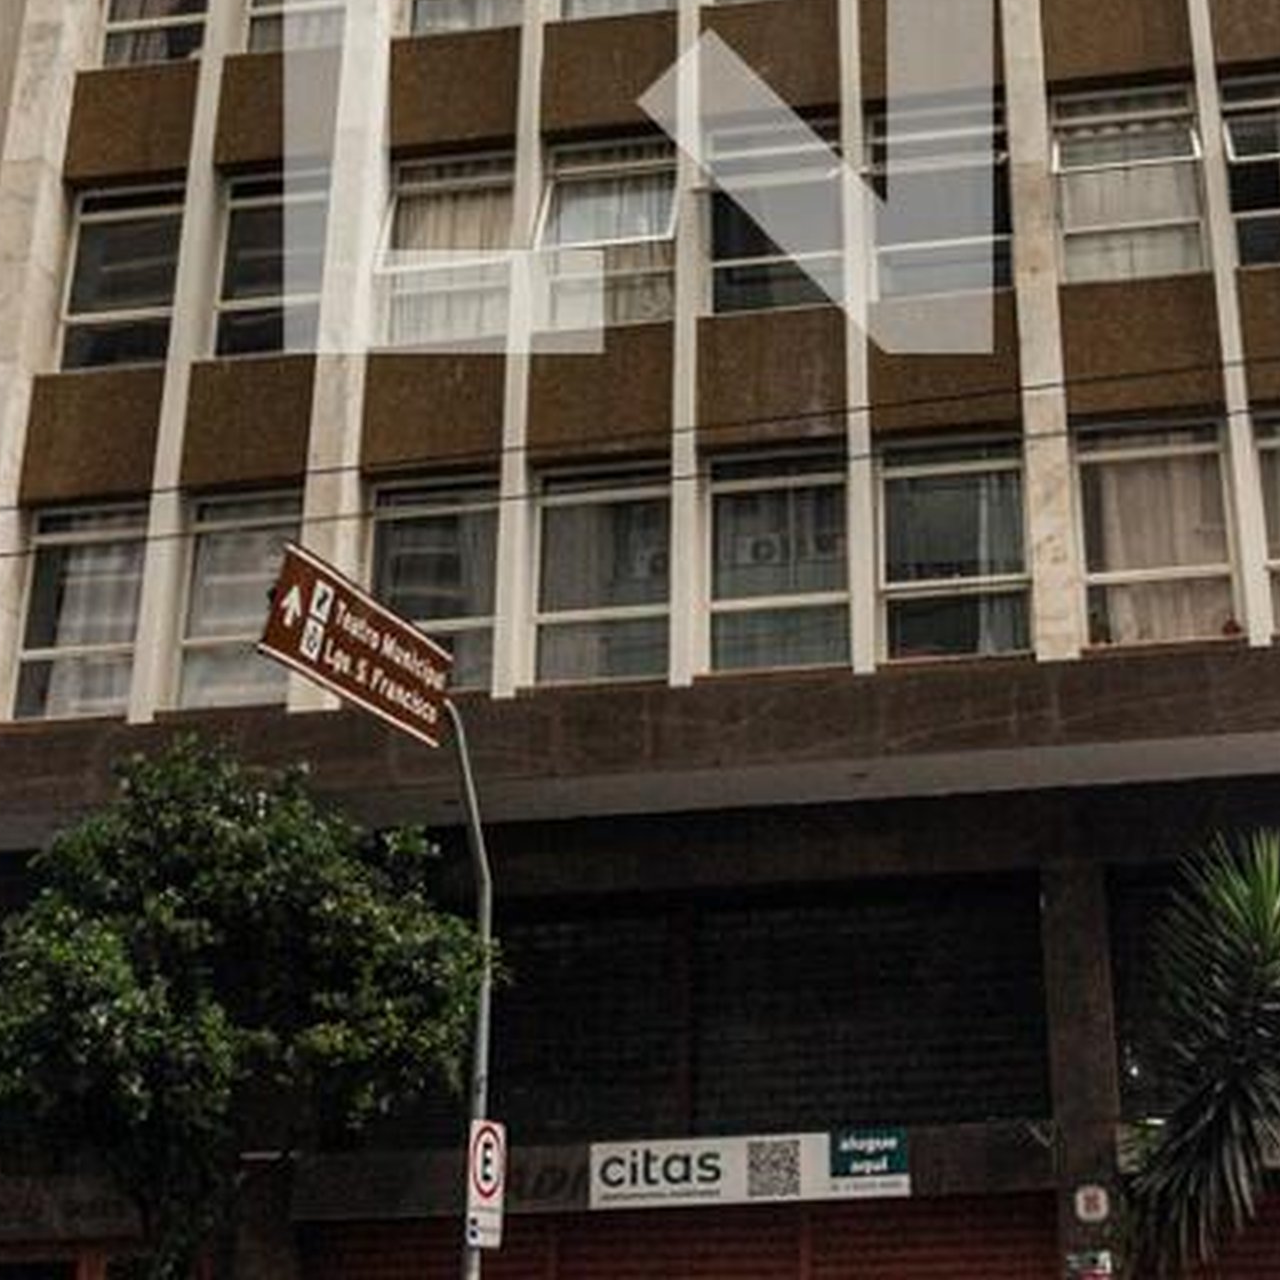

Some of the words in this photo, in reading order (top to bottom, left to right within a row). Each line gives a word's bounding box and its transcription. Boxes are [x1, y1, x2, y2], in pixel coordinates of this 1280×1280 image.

[335, 600, 379, 649] Teatro
[369, 670, 438, 724] Francisco
[481, 1141, 493, 1181] E
[838, 1135, 898, 1154] alugue
[850, 1154, 889, 1174] aqui
[599, 1149, 721, 1187] citas
